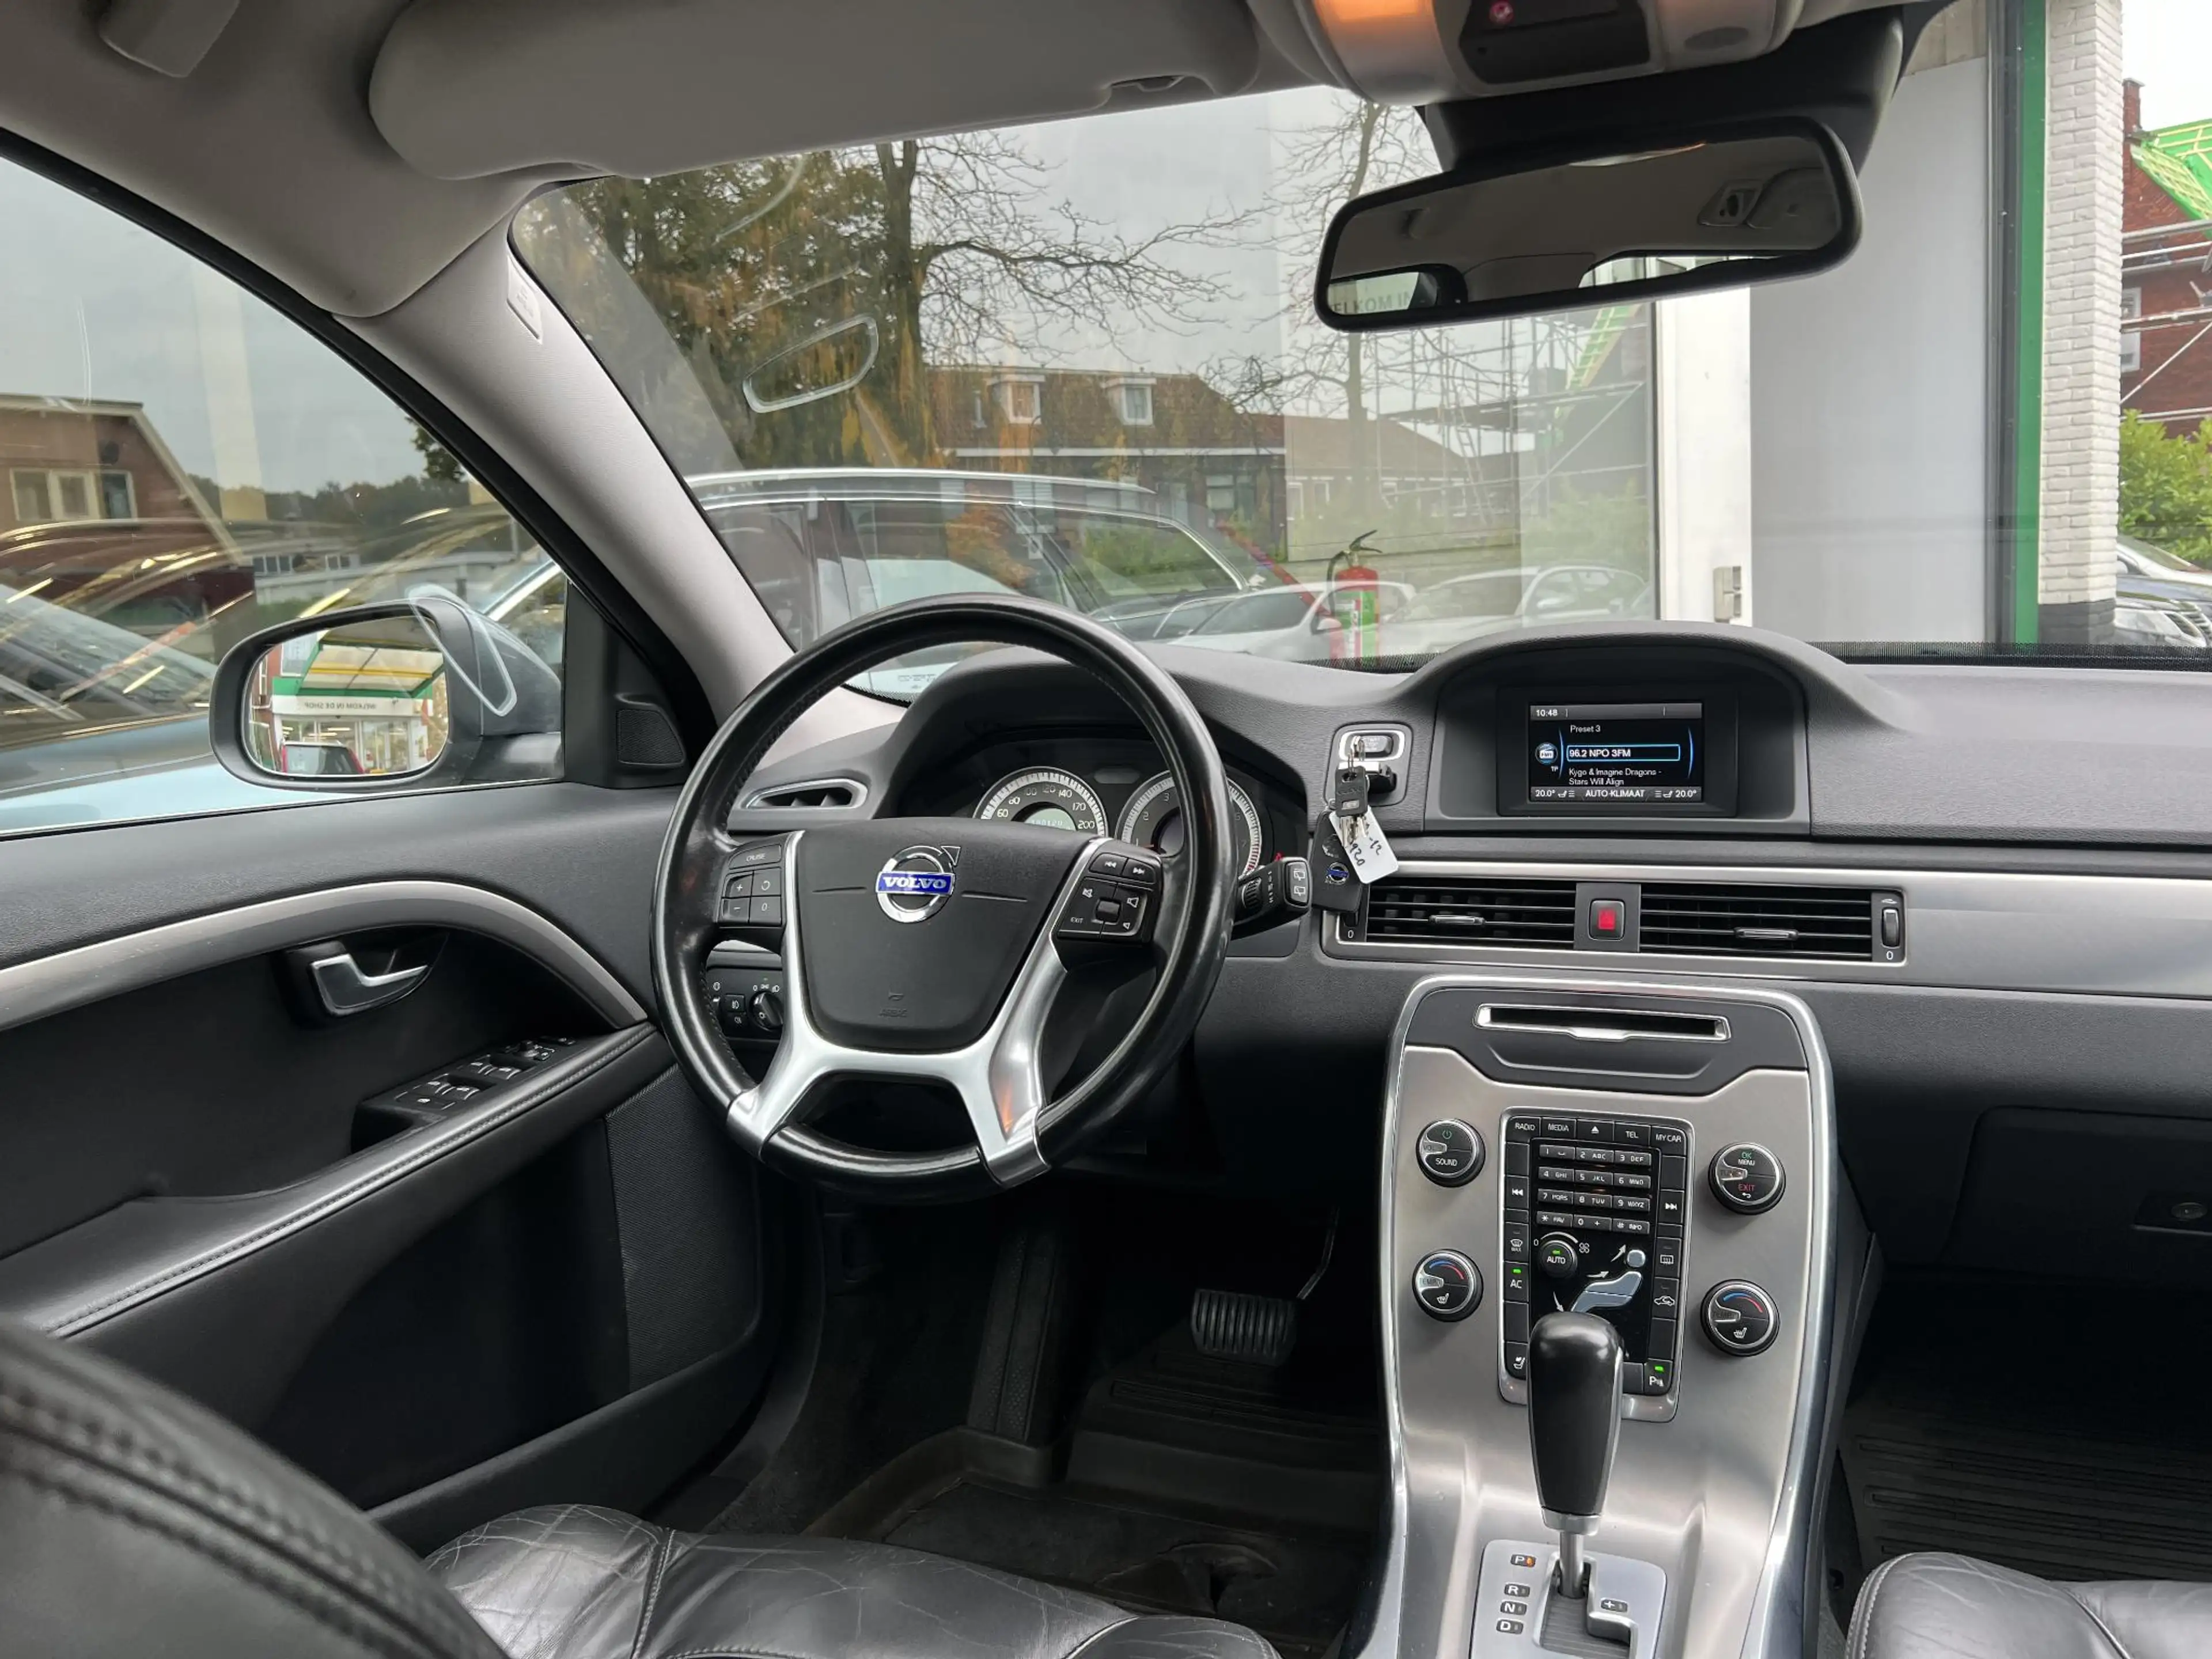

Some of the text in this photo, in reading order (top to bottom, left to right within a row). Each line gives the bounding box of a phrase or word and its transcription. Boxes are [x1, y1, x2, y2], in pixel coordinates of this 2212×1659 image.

[1331, 293, 1393, 315] ELKOM
[1536, 709, 1558, 717] 10:48
[1570, 725, 1594, 733] Preset
[1569, 749, 1631, 757] 96.2 NPO 3FM
[1569, 768, 1587, 777] Kygo
[1596, 768, 1623, 777] Imagine
[1625, 768, 1657, 777] Dragons
[1605, 778, 1624, 786] Align
[1058, 789, 1073, 798] 140
[1163, 792, 1171, 802] 3
[1585, 789, 1646, 798] AUTO-KLIMAAT
[1072, 802, 1086, 811] 170
[997, 809, 1009, 817] 60
[1142, 811, 1149, 821] 2
[1077, 820, 1095, 830] 200
[882, 876, 947, 889] VOLVO
[1887, 950, 1893, 960] 0
[1515, 1123, 1536, 1131] RADIO
[1547, 1123, 1569, 1132] MEDIA
[1626, 1130, 1639, 1139] TEL
[1666, 1135, 1681, 1143] CAR
[1580, 1151, 1585, 1159] 2
[1620, 1154, 1625, 1162] 3
[1435, 1157, 1458, 1166] SOUND
[1738, 1158, 1755, 1166] MENU
[1580, 1173, 1585, 1181] 5
[1619, 1177, 1624, 1185] 6
[1738, 1183, 1755, 1191] EXIT
[1543, 1192, 1548, 1200] 7
[1579, 1195, 1585, 1203] 8
[1627, 1200, 1645, 1209] WXYZ
[1578, 1218, 1584, 1226] 0
[1547, 1256, 1566, 1264] AUTO
[1510, 1279, 1522, 1289] AC
[1514, 1555, 1525, 1564] P
[1508, 1585, 1519, 1595] R
[1504, 1602, 1516, 1612] N
[1500, 1620, 1512, 1631] D
